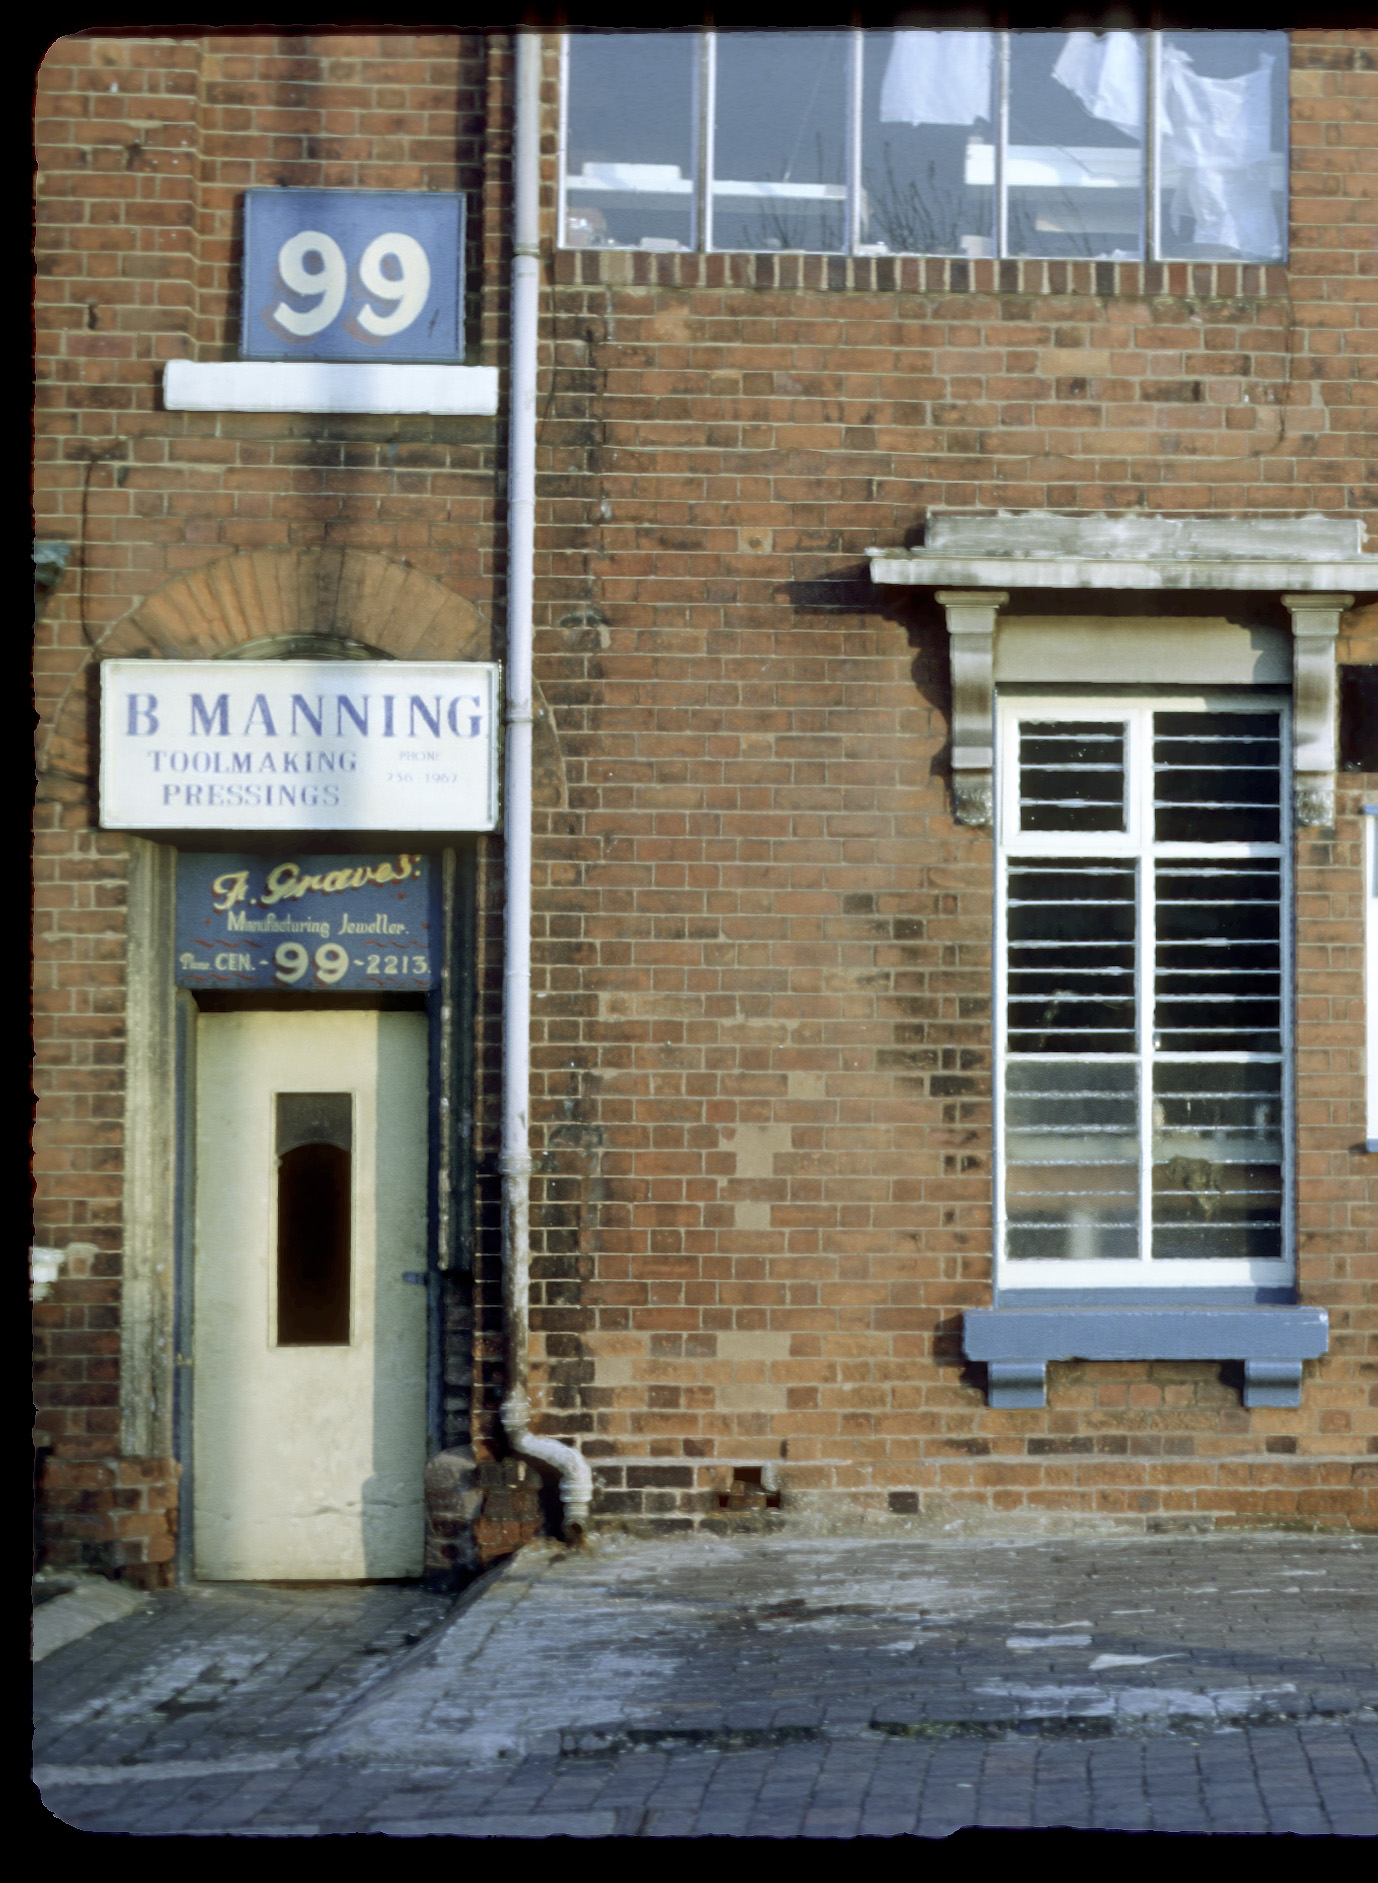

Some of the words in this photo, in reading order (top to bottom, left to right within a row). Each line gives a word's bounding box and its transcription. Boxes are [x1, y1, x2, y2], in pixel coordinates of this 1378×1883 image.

[272, 229, 431, 337] 99
[125, 692, 160, 737] B
[189, 692, 484, 739] MANNING
[147, 750, 358, 774] TOOLMAKING
[162, 783, 340, 807] PRESSINGS
[227, 910, 330, 938] Manufacturing
